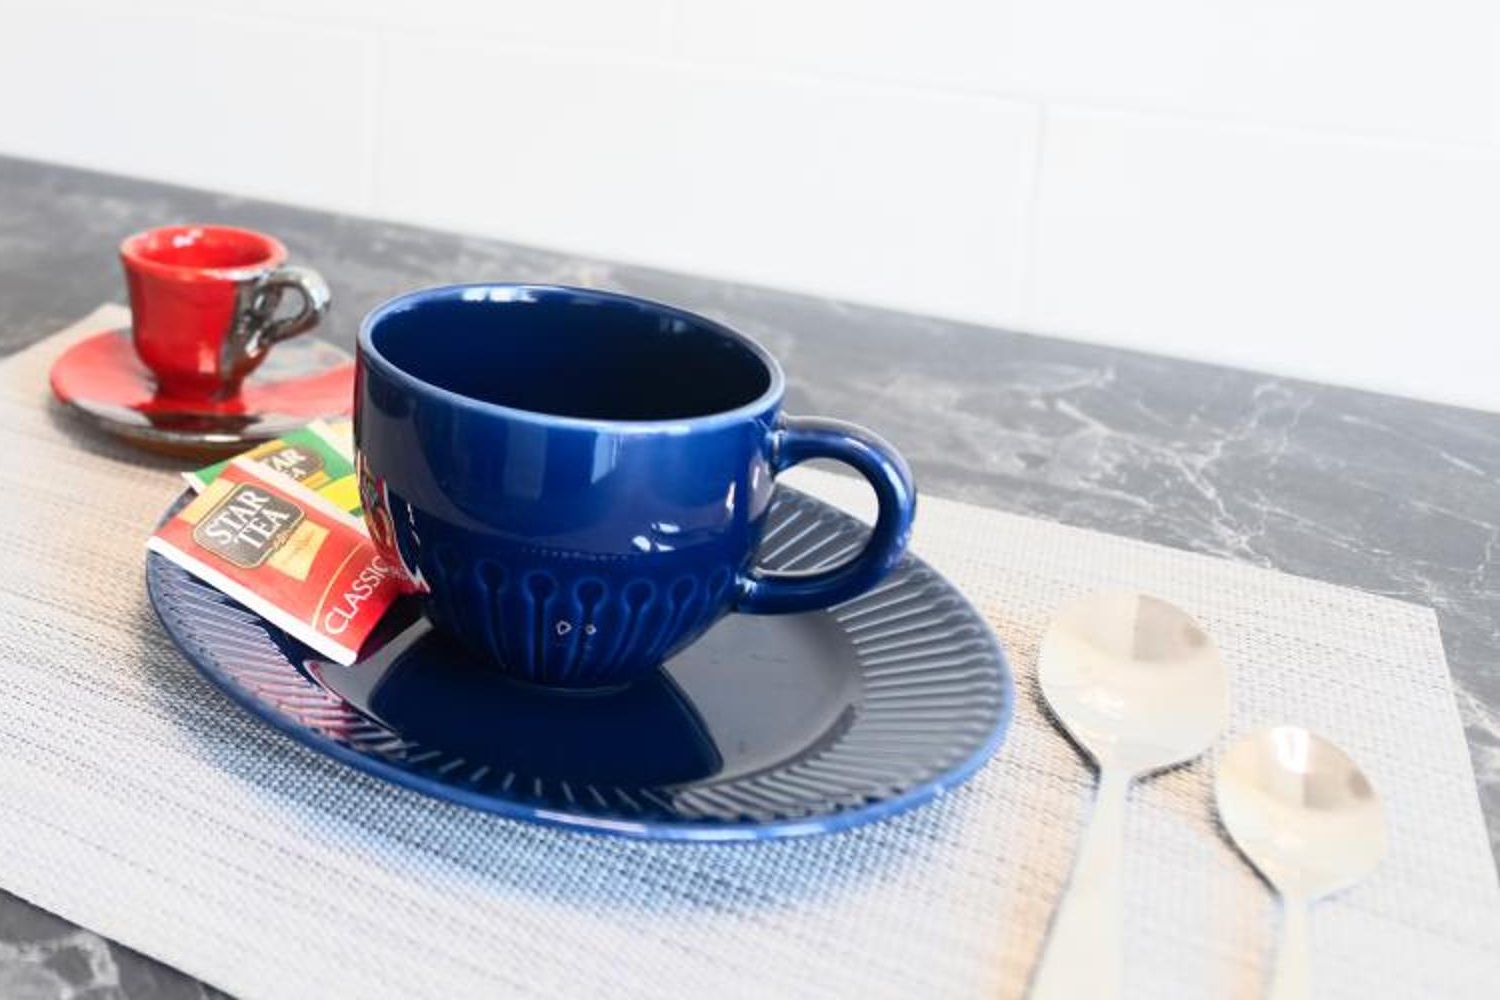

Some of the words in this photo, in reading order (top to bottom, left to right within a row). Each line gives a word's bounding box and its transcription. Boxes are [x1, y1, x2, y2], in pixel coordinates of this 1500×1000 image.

[205, 491, 270, 545] STAR
[233, 509, 291, 549] TEA
[323, 555, 389, 635] CLASSIC
